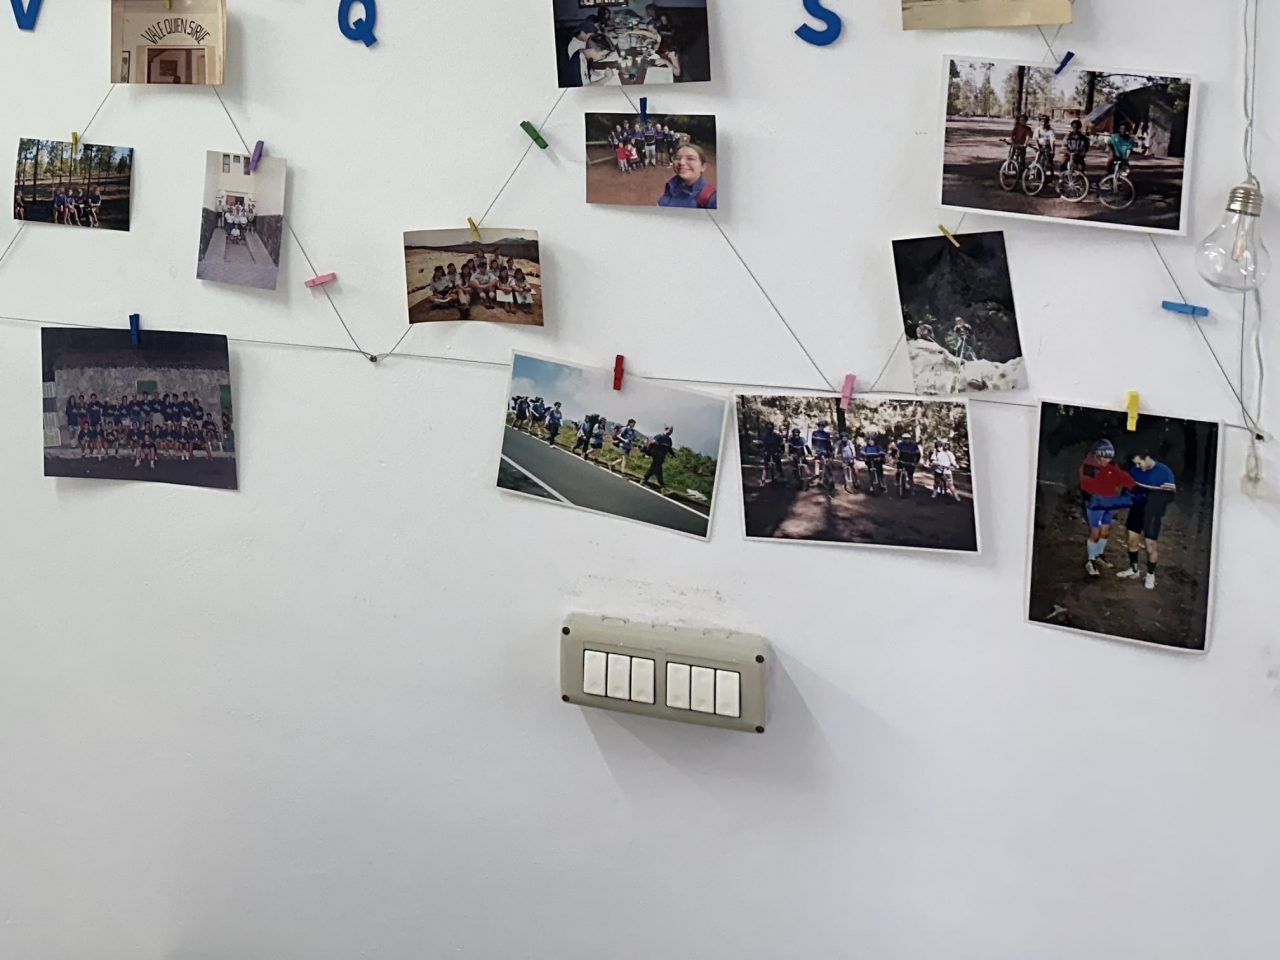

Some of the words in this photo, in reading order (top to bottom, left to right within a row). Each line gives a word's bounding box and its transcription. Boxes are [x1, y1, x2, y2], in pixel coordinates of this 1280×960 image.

[140, 21, 166, 45] VALE
[163, 17, 187, 35] QUIEN
[186, 20, 211, 45] SIRVE
